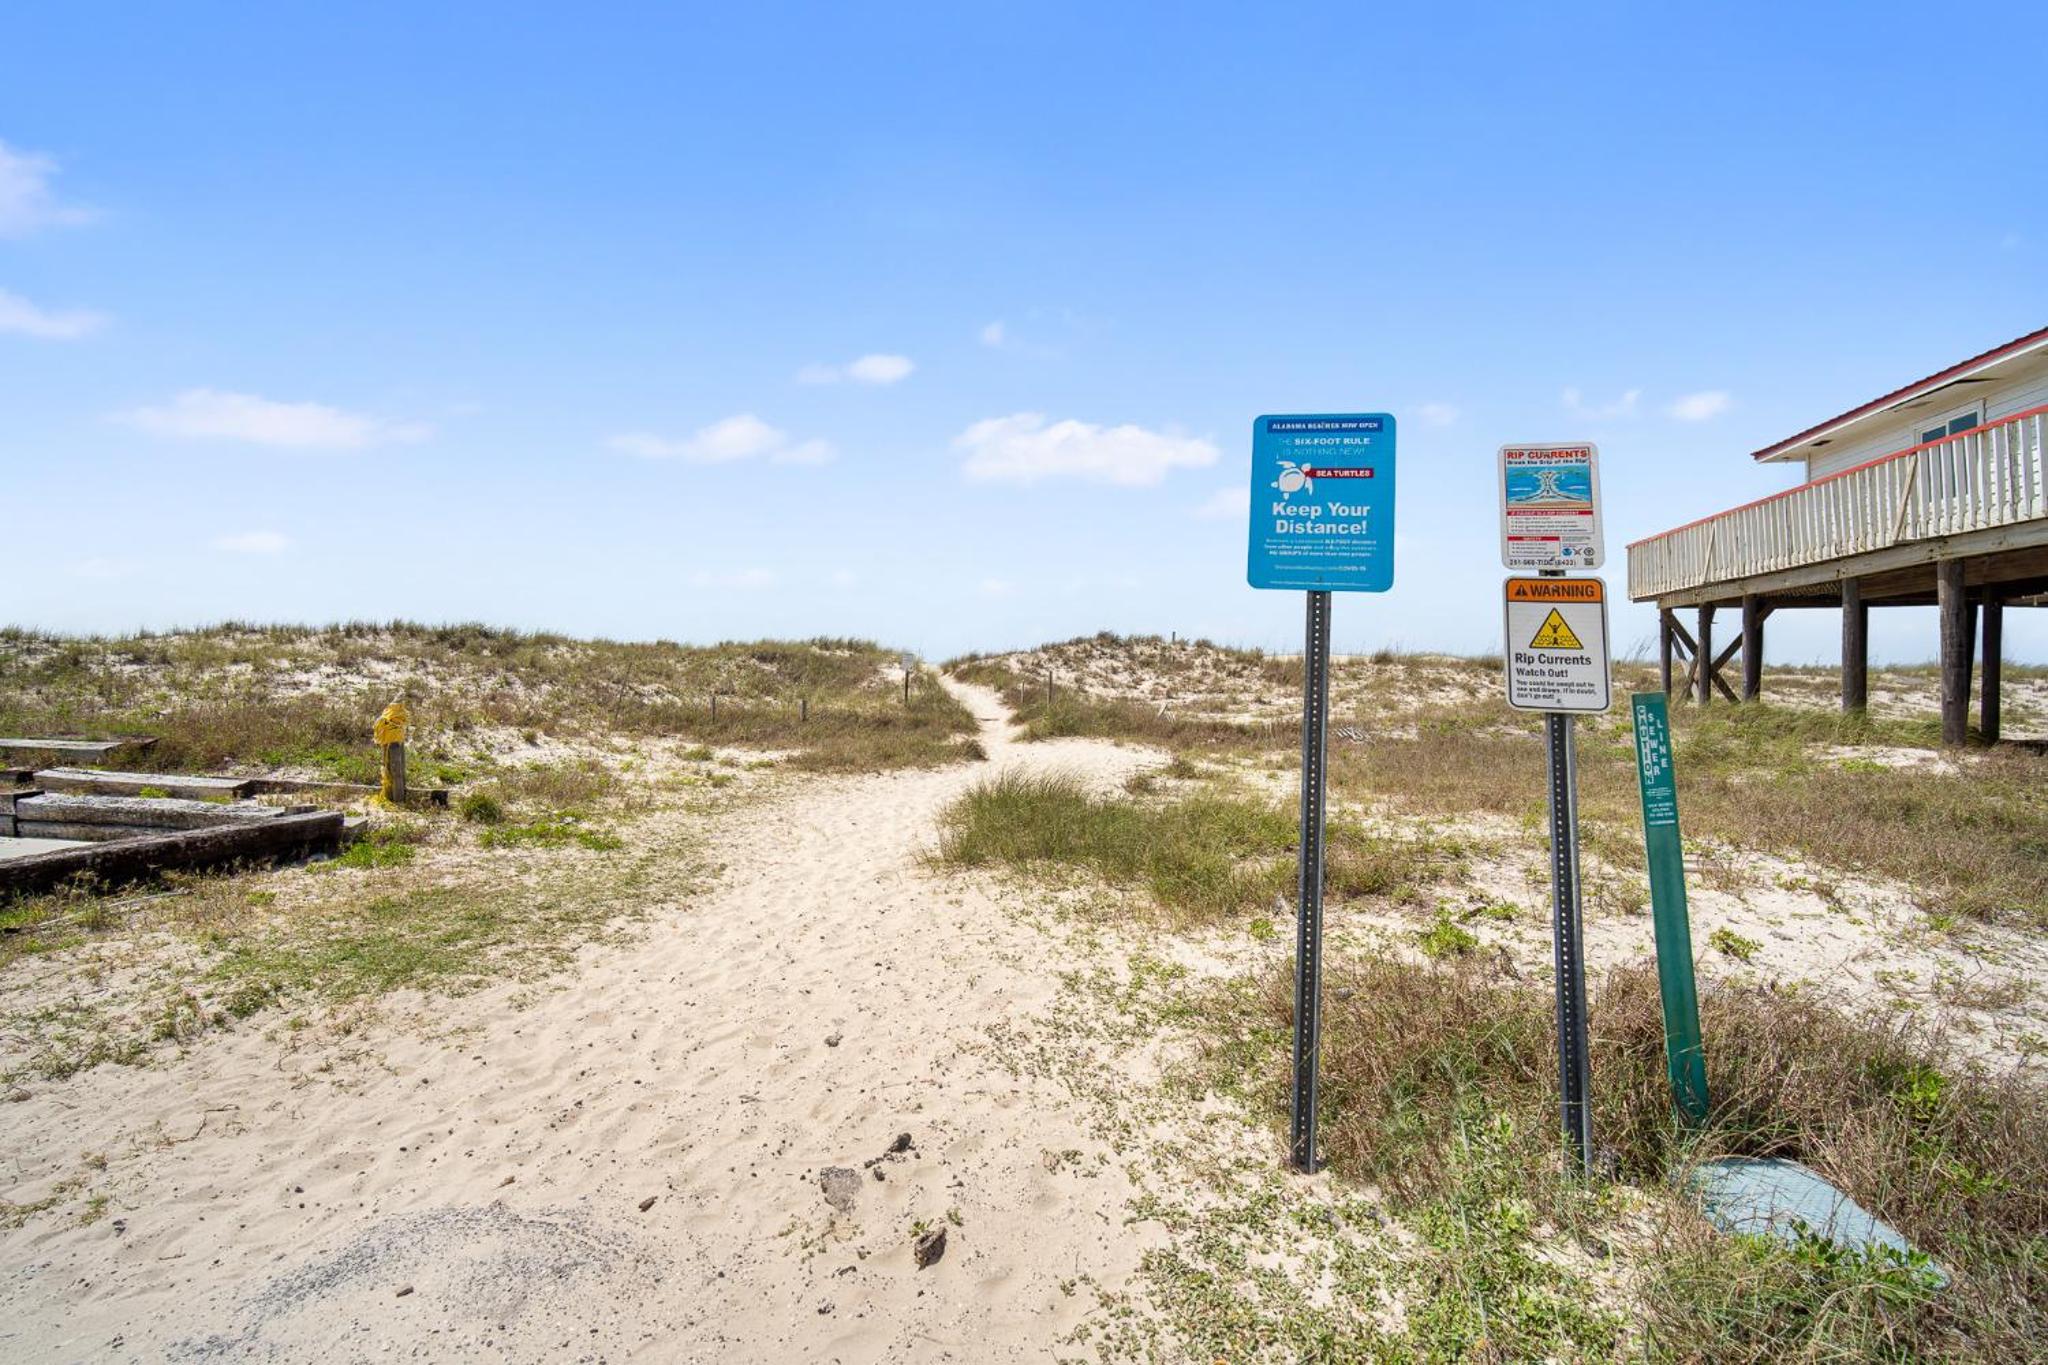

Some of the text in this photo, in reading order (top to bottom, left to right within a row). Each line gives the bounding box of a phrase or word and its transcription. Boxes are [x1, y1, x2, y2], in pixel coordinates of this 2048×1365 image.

[1506, 450, 1588, 459] RIP CURRENTS
[1334, 470, 1370, 478] TURTLES
[1272, 502, 1370, 518] Keep Your
[1276, 519, 1367, 534] Distance!
[1530, 585, 1594, 597] WARNING
[1515, 653, 1592, 666] Rip Currents
[1516, 668, 1568, 678] Watch Out!
[1647, 713, 1660, 776] SEWER
[1656, 719, 1668, 768] LINE
